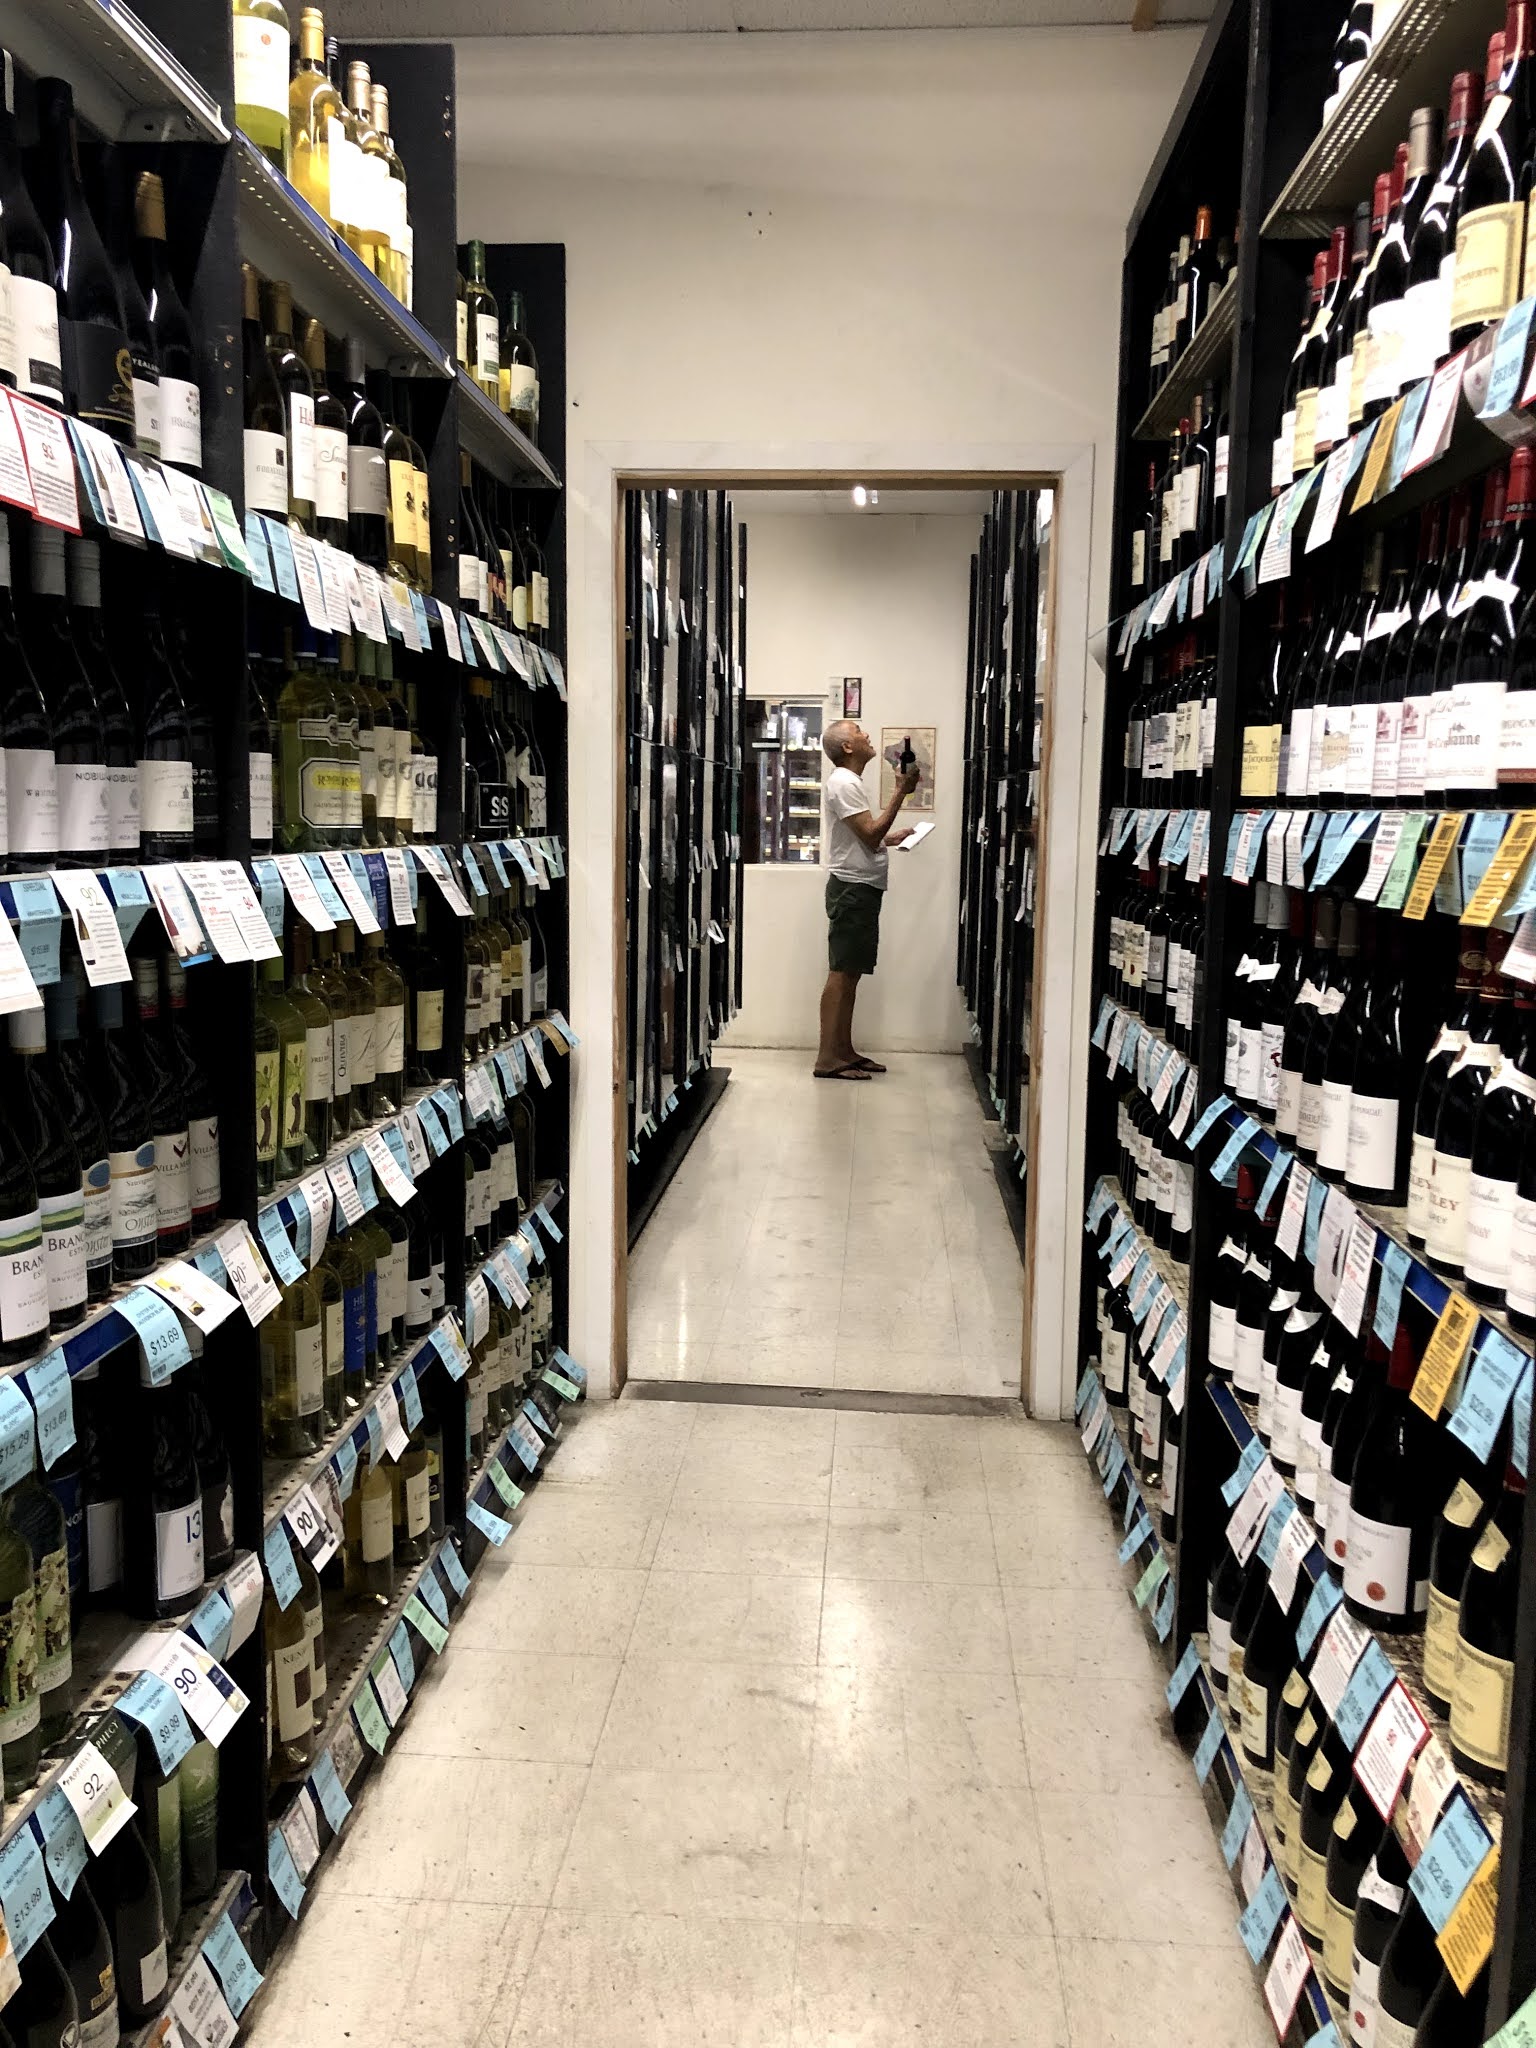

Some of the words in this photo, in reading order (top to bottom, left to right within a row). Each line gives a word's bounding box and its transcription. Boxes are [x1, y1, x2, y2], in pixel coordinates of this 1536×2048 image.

[80, 886, 103, 906] 92
[231, 1265, 247, 1288] 90
[150, 1327, 180, 1356] $13.69
[297, 1511, 313, 1536] 90
[174, 1667, 197, 1695] 90
[160, 1714, 181, 1743] $9.99
[82, 1772, 104, 1801] 92
